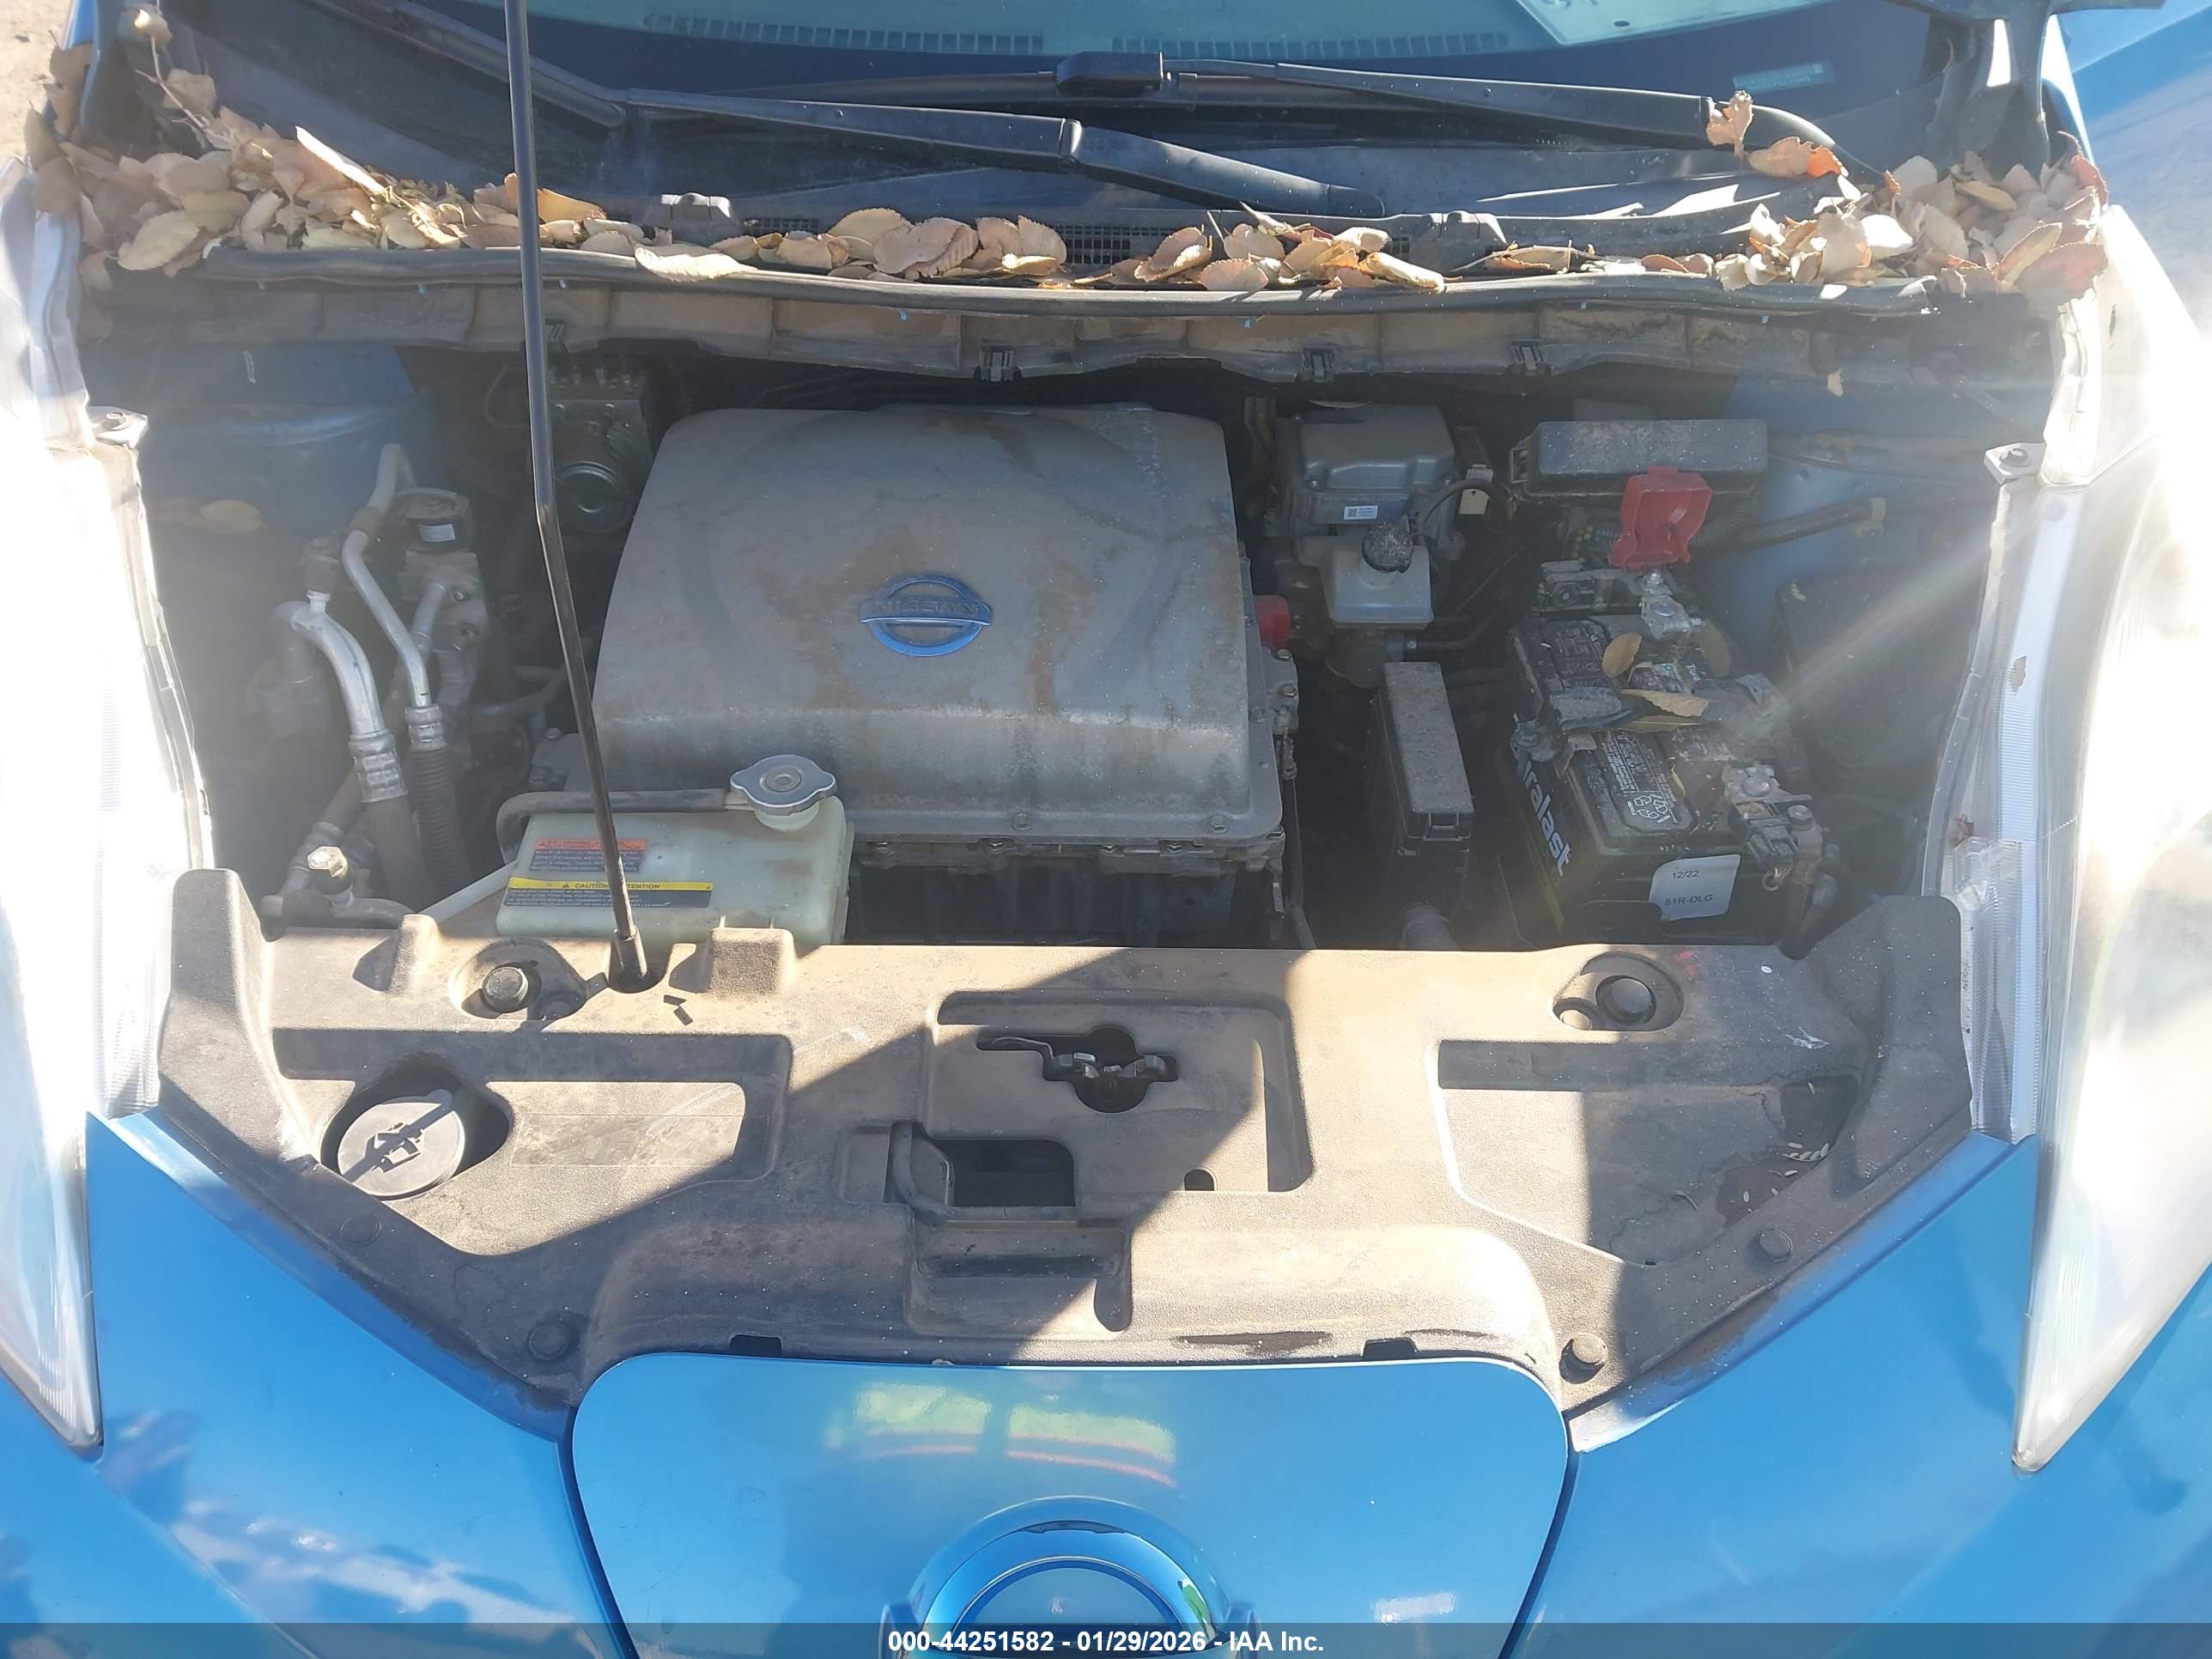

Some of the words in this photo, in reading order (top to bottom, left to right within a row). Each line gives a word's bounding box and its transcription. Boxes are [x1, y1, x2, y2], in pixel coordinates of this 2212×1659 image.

[873, 599, 975, 615] NISSAN
[1672, 870, 1700, 879] 12/22
[1666, 894, 1714, 906] 51R-DLG
